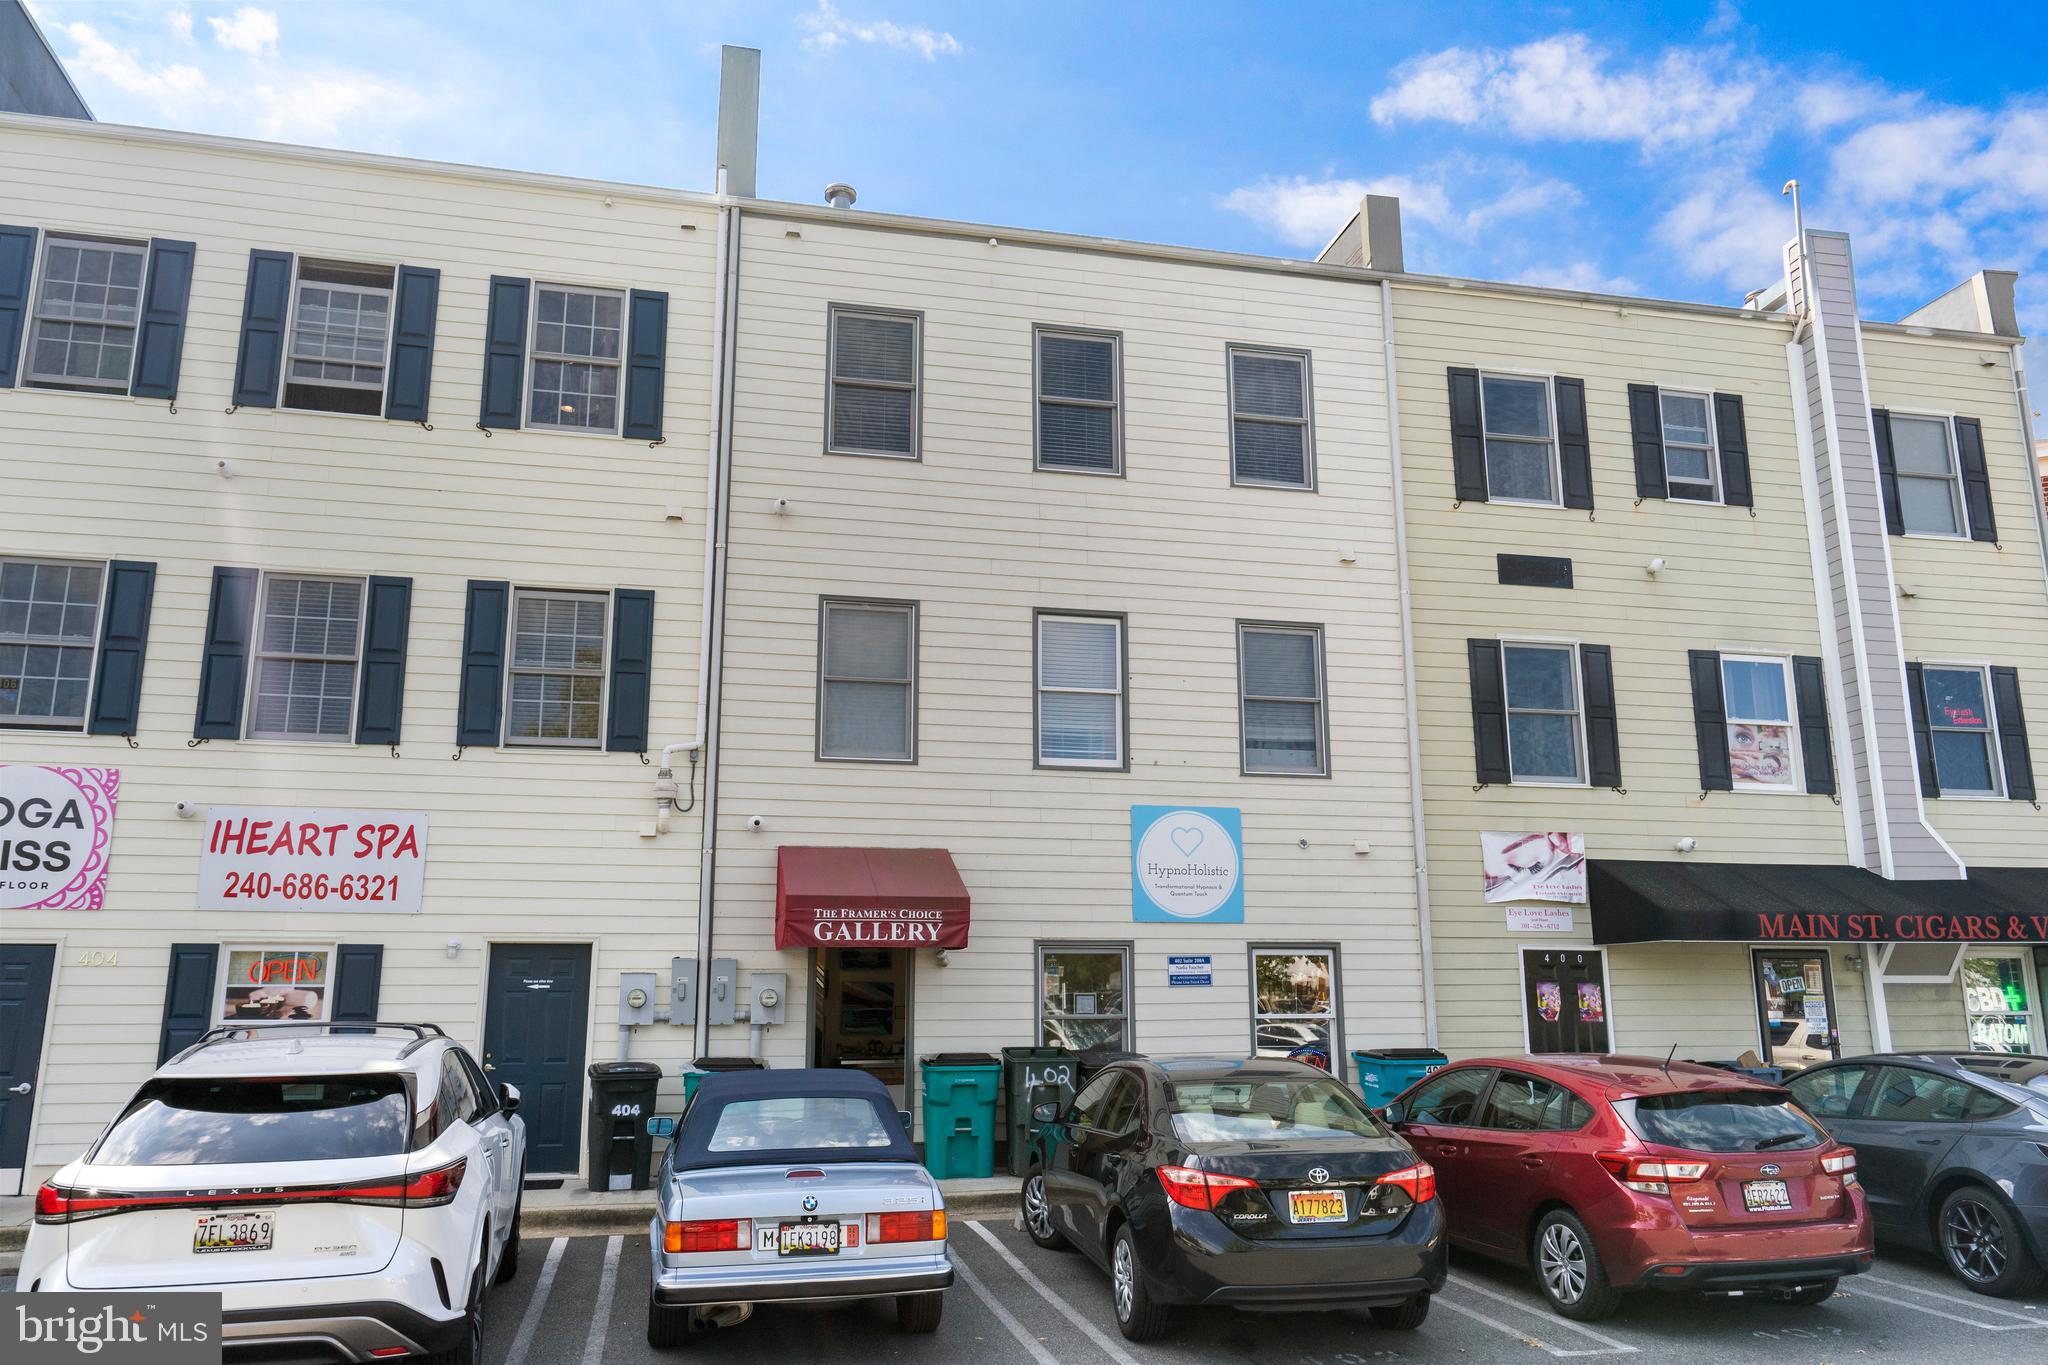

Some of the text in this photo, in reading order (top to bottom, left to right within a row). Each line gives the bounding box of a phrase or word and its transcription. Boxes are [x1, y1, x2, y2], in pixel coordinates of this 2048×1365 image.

[0, 679, 17, 689] 06
[210, 818, 419, 859] IHEART SPA
[1148, 863, 1229, 878] HypnoHolistic
[223, 872, 399, 901] 240-686-6321
[814, 908, 943, 919] THE FRAMER'S CHOICE
[1508, 909, 1522, 917] Eye
[813, 921, 944, 941] GALLERY
[1758, 914, 1840, 938] MAIN
[1848, 914, 1889, 938] ST.
[1895, 914, 2000, 938] CIGARS
[2007, 915, 2028, 939] &
[78, 951, 119, 967] 404
[249, 958, 318, 984] OPEN
[1781, 978, 1804, 992] OPEN
[1966, 987, 2007, 1012] CBD
[1026, 1065, 1076, 1103] 402
[611, 1104, 640, 1117] 404
[186, 1186, 284, 1197] LEXUS
[1293, 1200, 1344, 1215] A177823
[763, 1231, 774, 1247] M
[783, 1230, 837, 1250] 1EK3198
